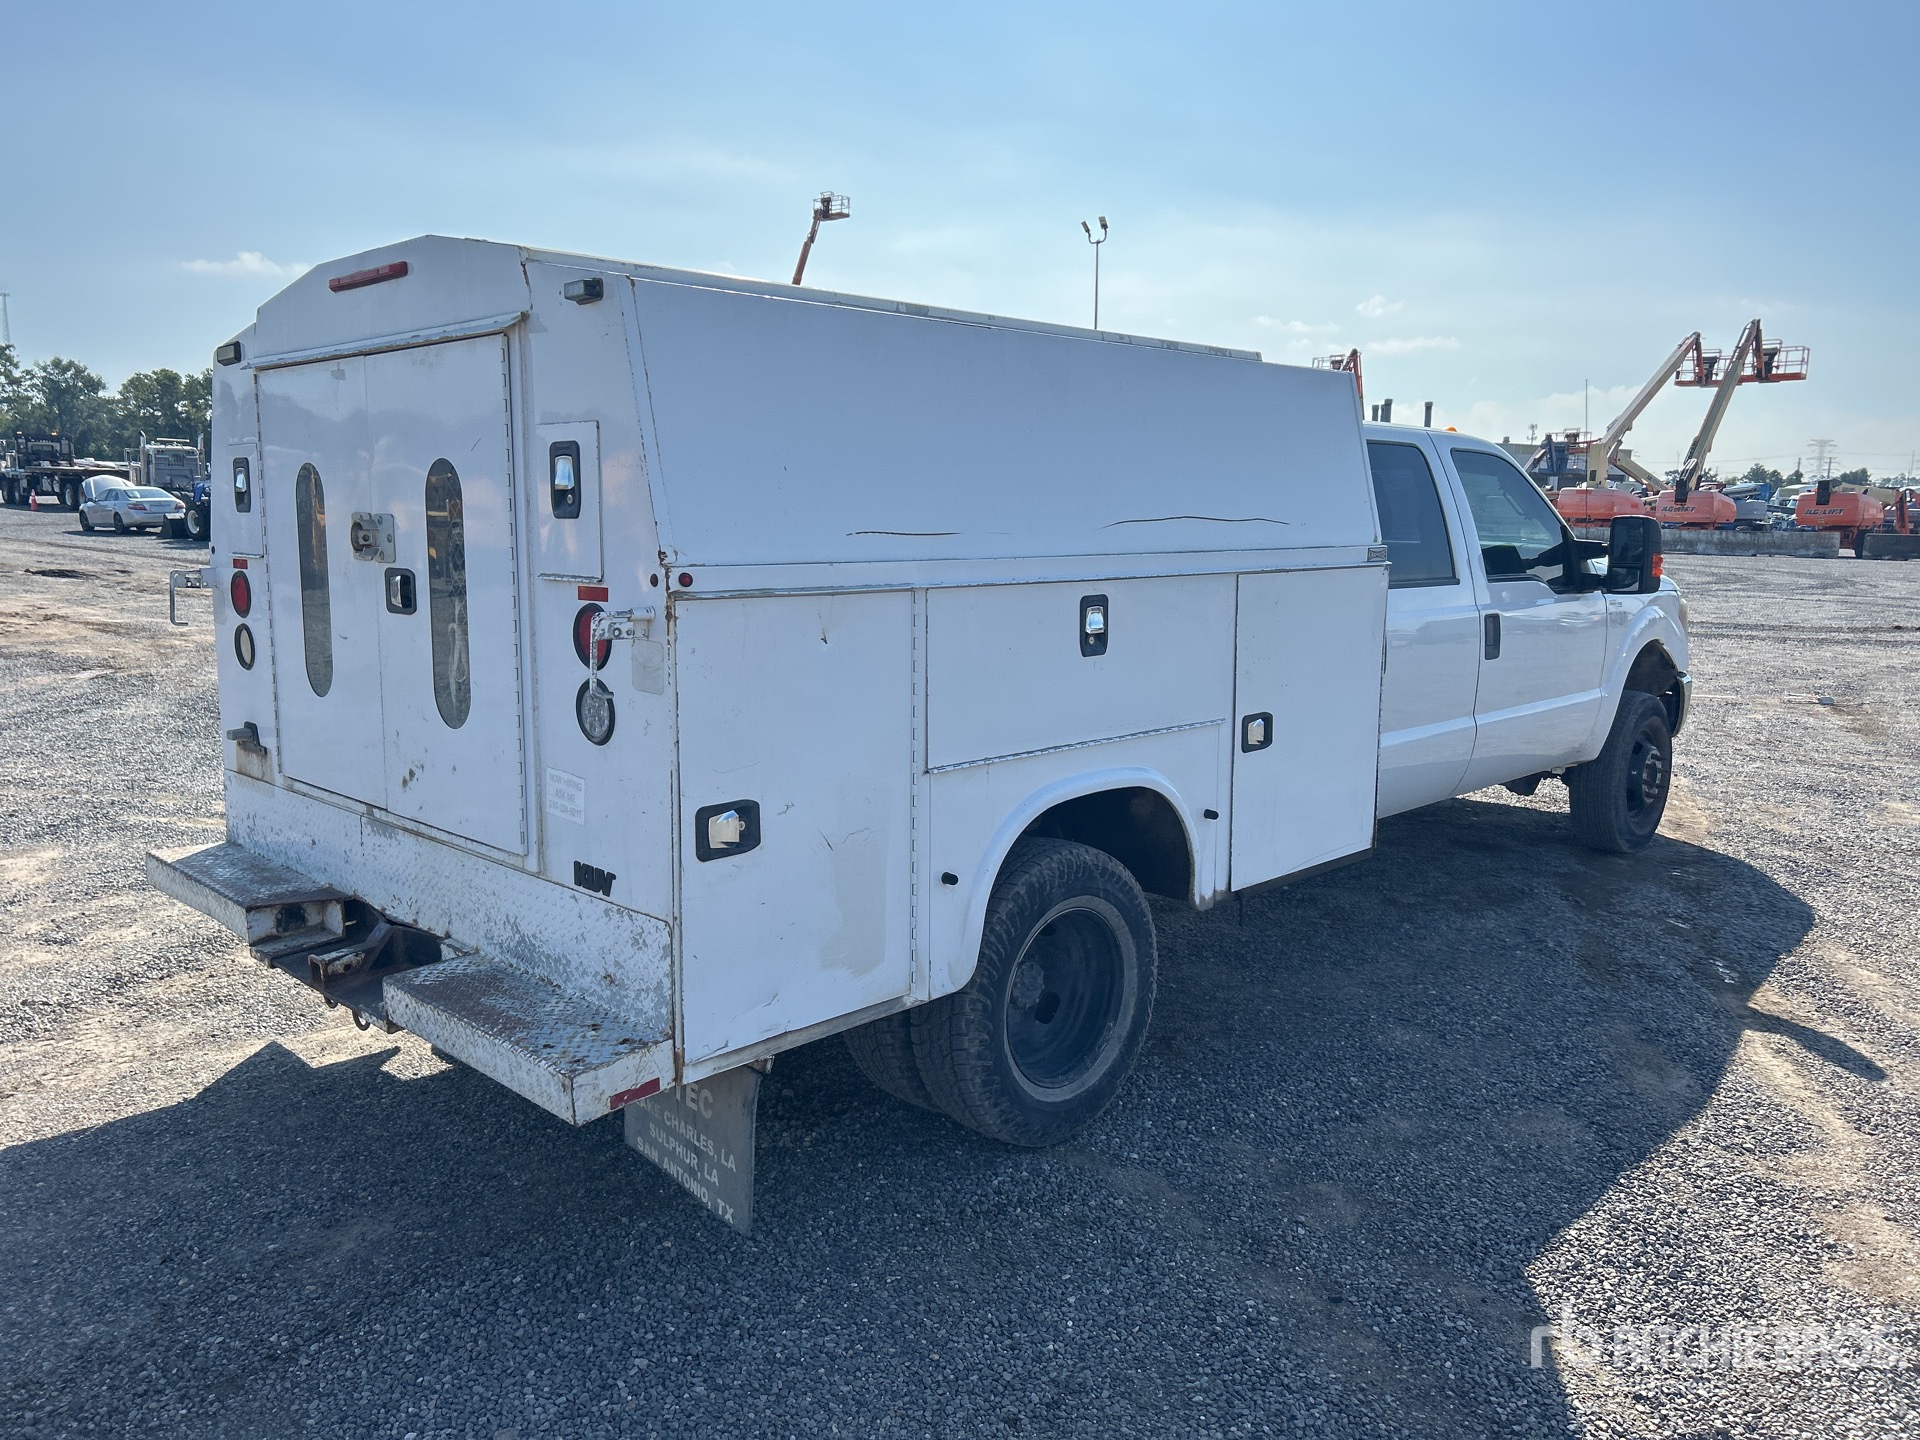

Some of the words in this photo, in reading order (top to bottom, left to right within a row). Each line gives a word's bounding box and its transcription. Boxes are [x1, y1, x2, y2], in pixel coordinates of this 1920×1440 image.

[573, 860, 617, 897] KUV
[650, 1122, 700, 1180] SULPHUR,
[704, 1162, 719, 1186] LA
[664, 1111, 718, 1162] CHARLES,
[721, 1149, 736, 1172] LA
[637, 1136, 659, 1163] SAN
[663, 1157, 711, 1209] ANTONIO,
[717, 1198, 734, 1224] TX
